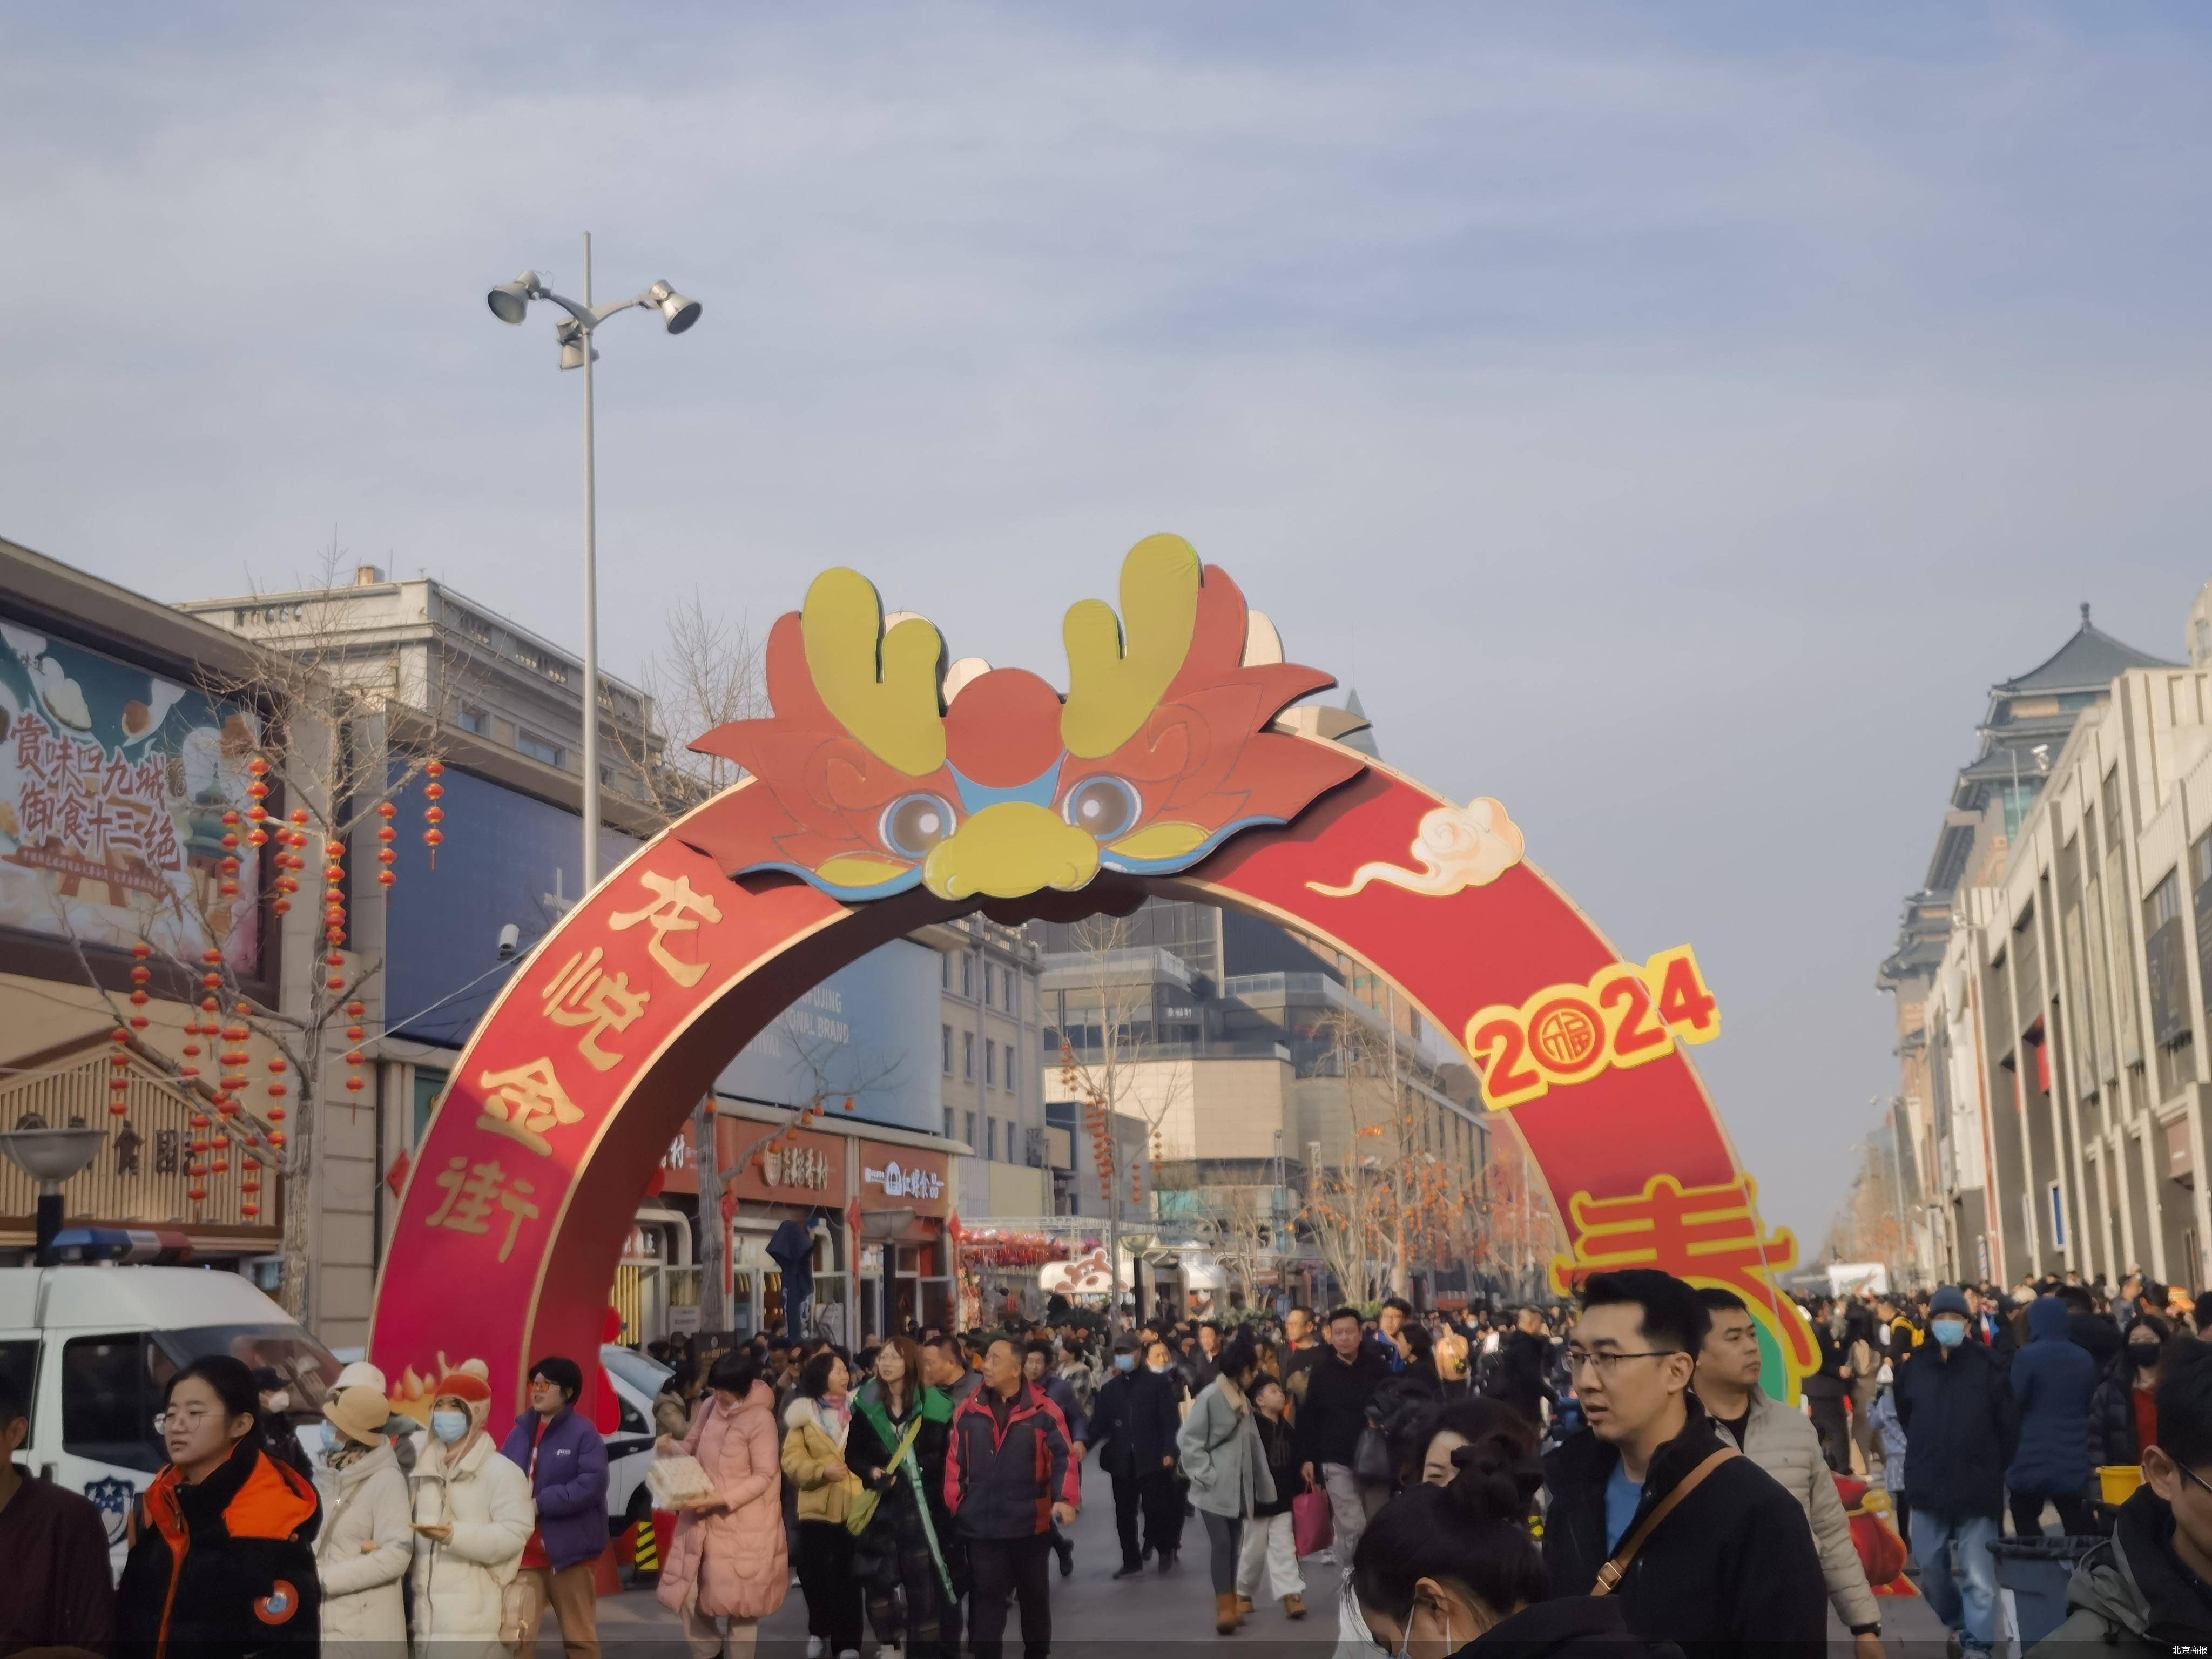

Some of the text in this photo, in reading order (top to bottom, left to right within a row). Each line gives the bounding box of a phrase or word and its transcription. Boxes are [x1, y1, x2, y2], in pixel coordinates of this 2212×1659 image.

[10, 713, 166, 812] 赏味四九城
[19, 781, 181, 872] 御食十三绝
[425, 869, 724, 1264] 龙悦金街
[818, 1016, 849, 1044] BRAND
[1474, 956, 1716, 1098] 2024
